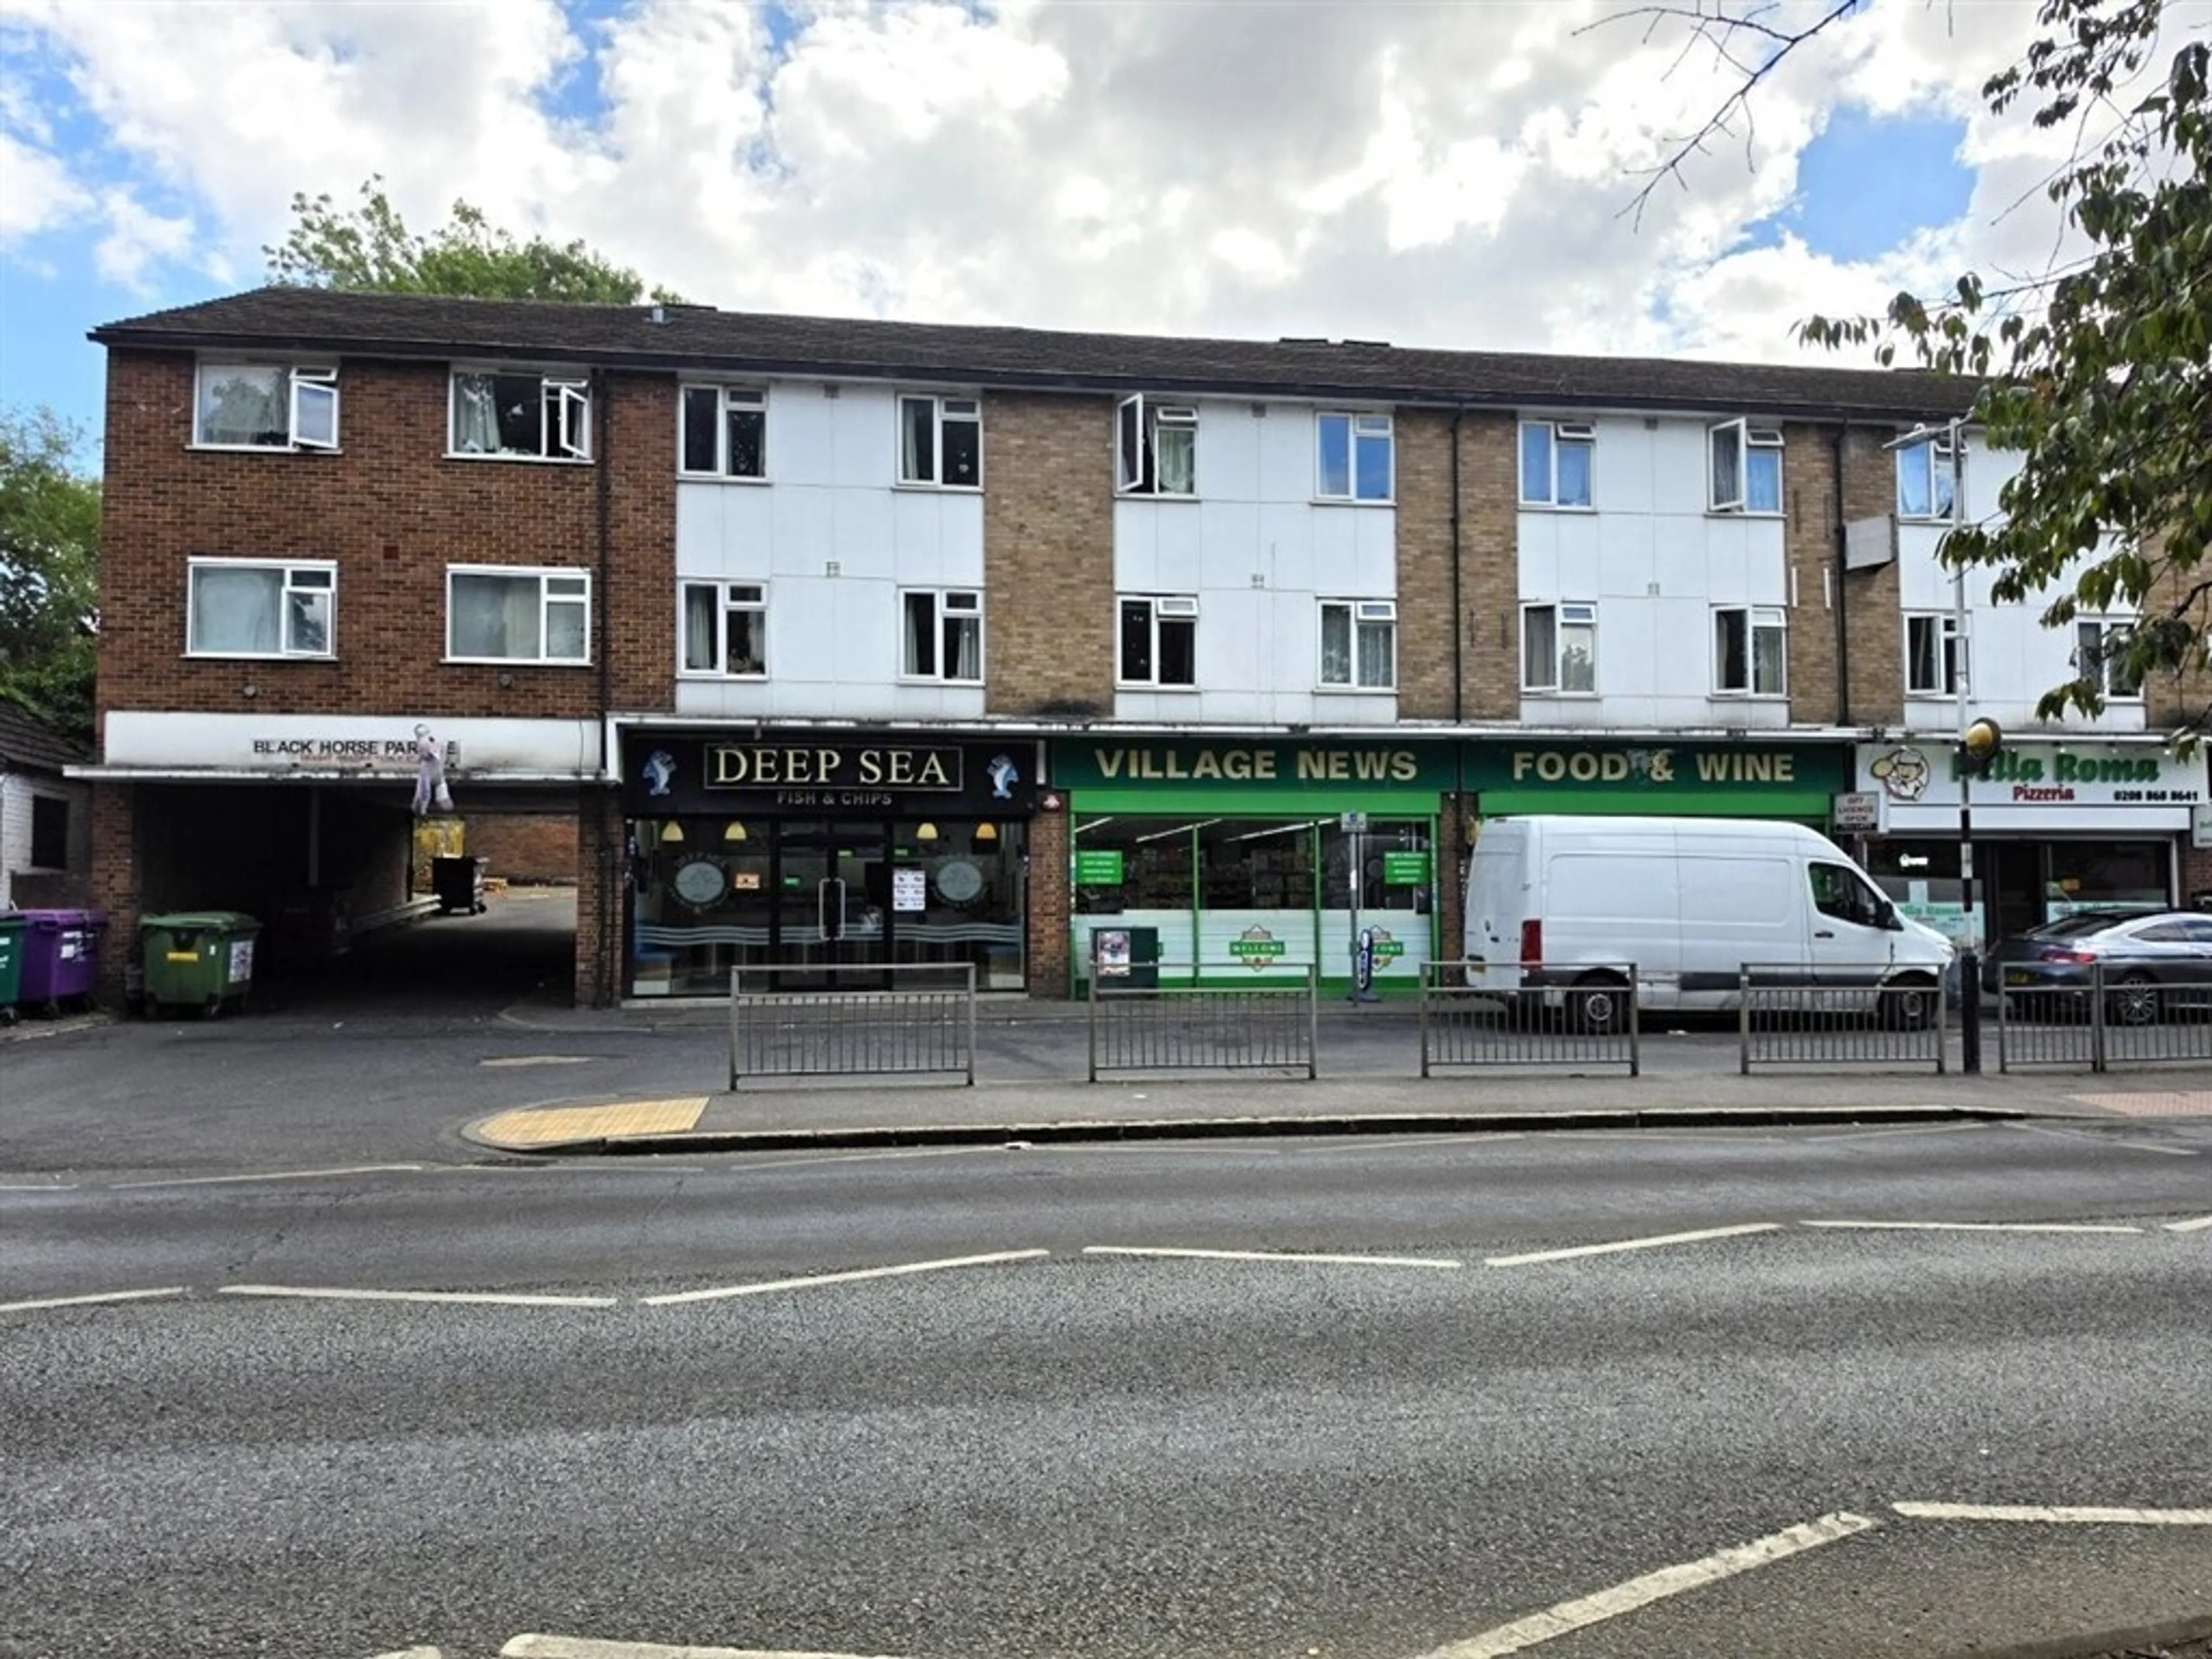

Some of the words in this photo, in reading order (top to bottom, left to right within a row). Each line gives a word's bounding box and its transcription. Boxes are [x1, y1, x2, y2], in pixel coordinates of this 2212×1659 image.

[254, 740, 312, 755] BLACK
[320, 741, 377, 755] HORSE
[385, 741, 456, 755] PARE
[714, 749, 841, 783] DEEP
[859, 750, 950, 785] SEA
[1095, 749, 1277, 779] VILLAGE
[1298, 751, 1418, 781] NEWS
[1513, 752, 1628, 781] FOOD
[1650, 751, 1673, 782] &
[1696, 753, 1794, 782] WINE
[1950, 751, 2044, 782] lla
[2054, 755, 2161, 783] Roma
[777, 791, 816, 805] FISH
[823, 791, 835, 805] &
[842, 793, 892, 805] CHIPS
[2013, 784, 2075, 801] Pizzeria
